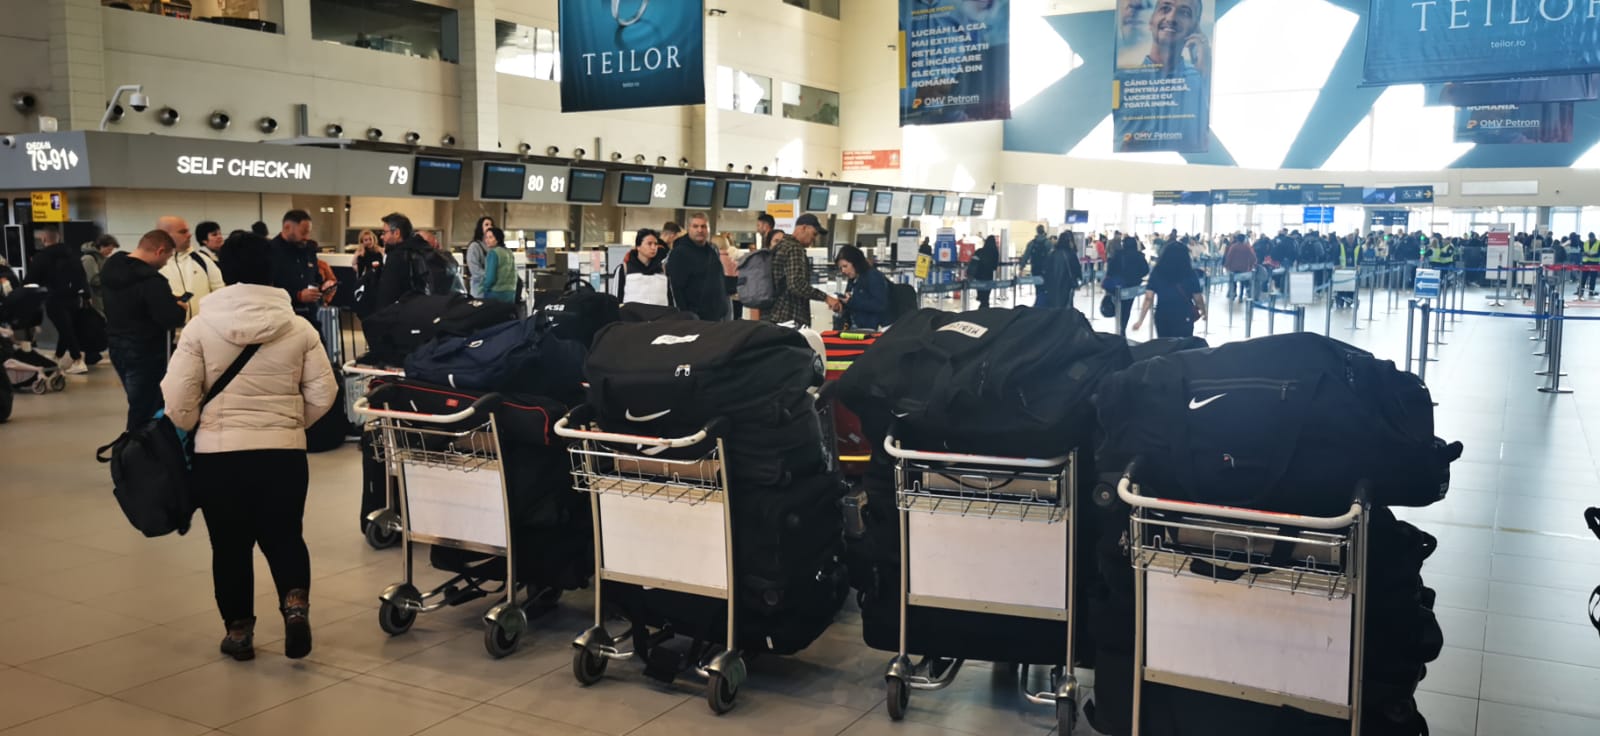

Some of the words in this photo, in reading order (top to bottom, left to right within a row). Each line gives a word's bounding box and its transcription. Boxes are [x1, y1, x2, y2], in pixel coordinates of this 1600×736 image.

[952, 24, 965, 33] LA
[966, 22, 987, 30] CEA
[912, 39, 928, 48] MAI
[1490, 39, 1526, 48] teilor.ro
[944, 46, 958, 54] DE
[582, 45, 682, 75] TEILOR
[912, 59, 924, 68] DE
[965, 64, 983, 73] DIN
[1124, 86, 1158, 94] PENTRU
[924, 97, 945, 107] OMV
[947, 94, 980, 105] Petrom
[1480, 119, 1503, 128] OMV
[1505, 119, 1540, 128] Petrom
[1134, 132, 1152, 140] OMV
[1153, 131, 1182, 140] Petrom
[27, 148, 70, 171] 79-91
[176, 155, 225, 175] SELF
[227, 158, 311, 180] CHECK-IN
[388, 165, 408, 185] 79
[528, 175, 544, 192] 80
[550, 176, 565, 192] 81
[653, 183, 667, 198] 82
